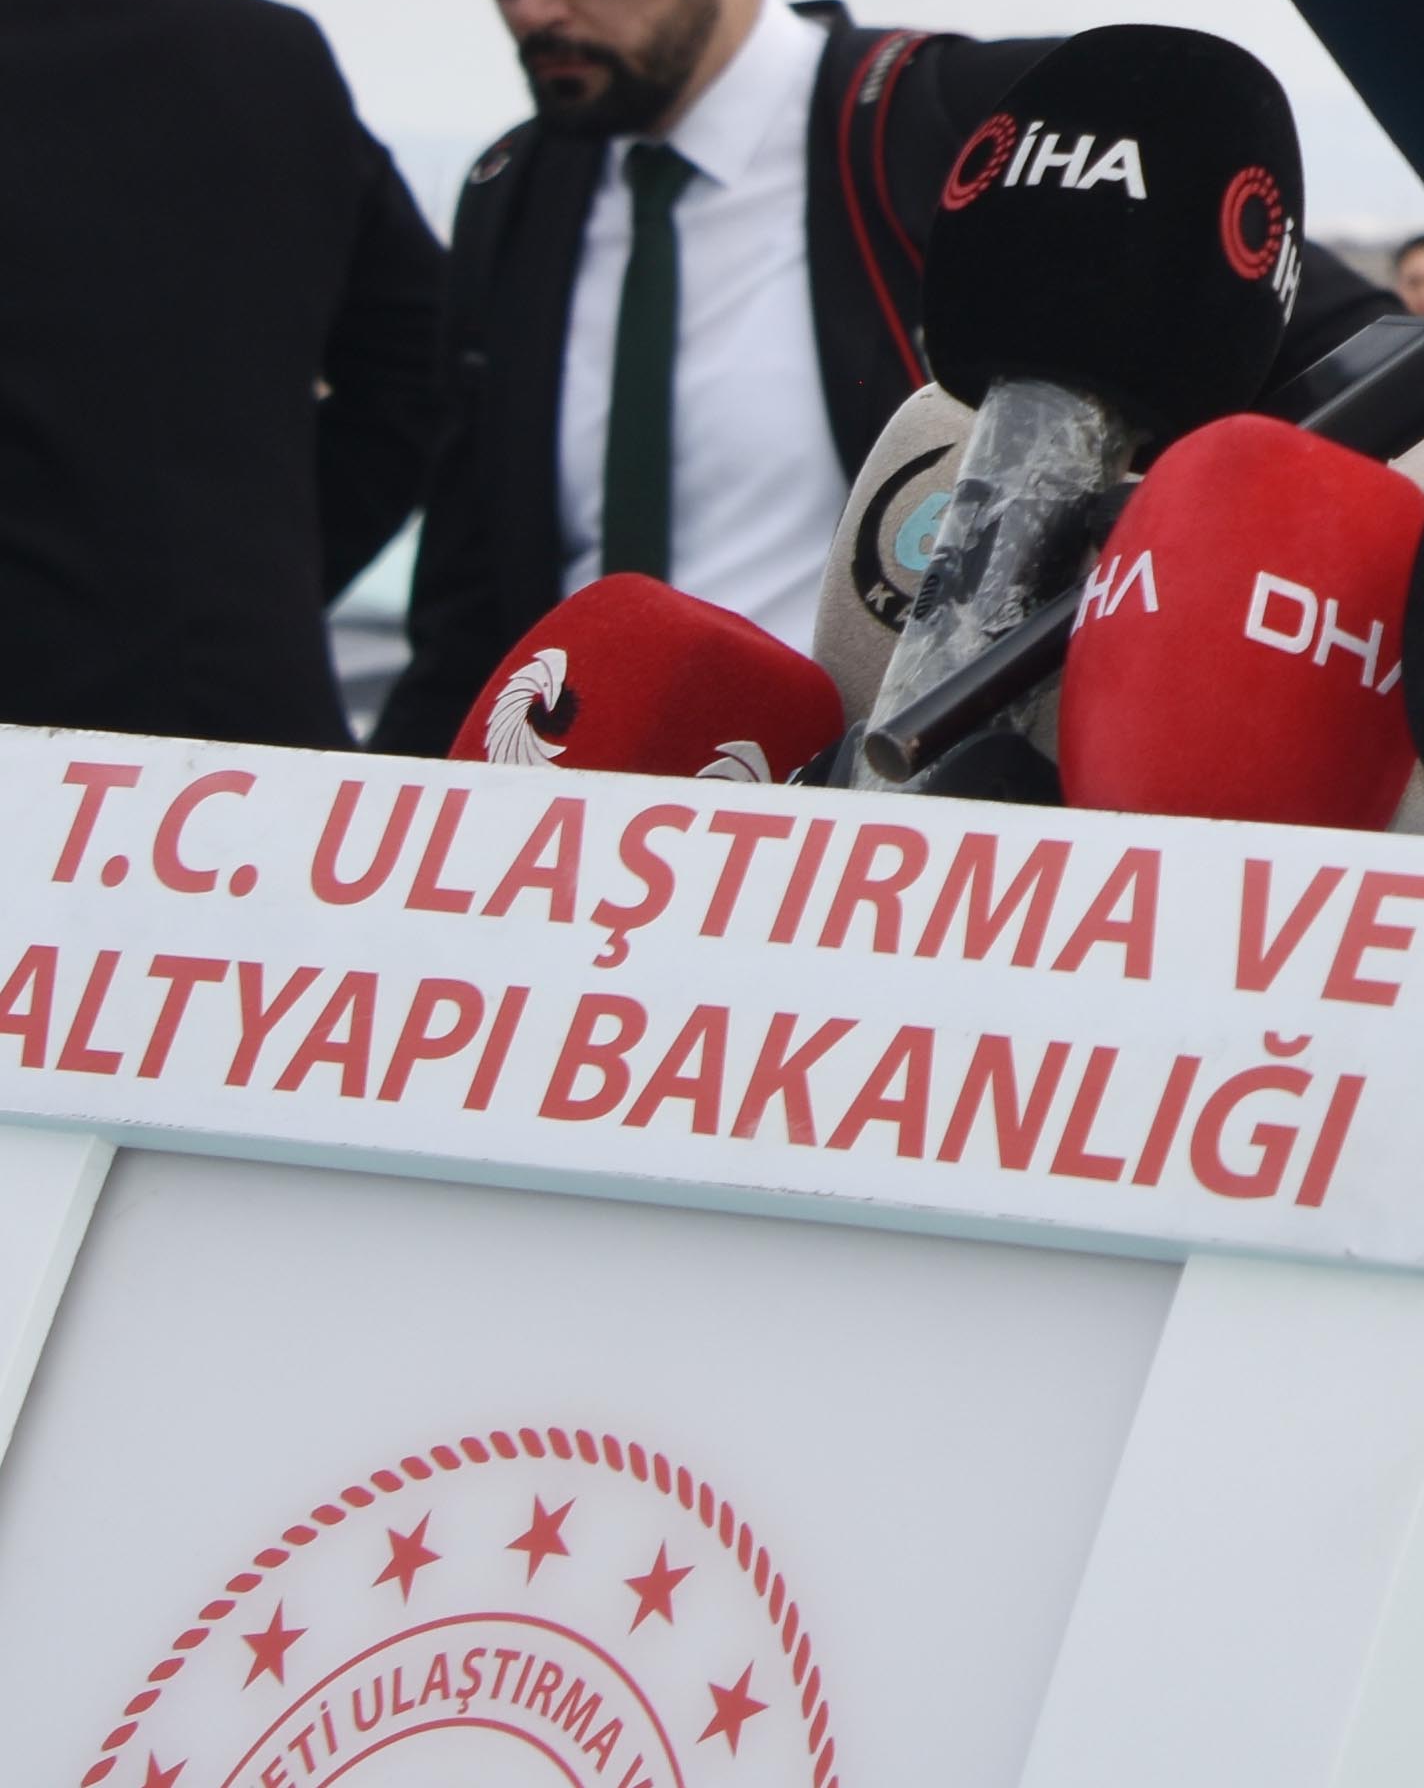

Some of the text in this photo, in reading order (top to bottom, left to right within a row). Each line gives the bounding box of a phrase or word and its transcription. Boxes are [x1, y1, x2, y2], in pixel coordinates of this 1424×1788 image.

[1004, 121, 1147, 199] İHA
[52, 761, 259, 898] T.C.
[310, 780, 1161, 981] ULAŞTIRMA
[0, 945, 1366, 1208] ALTYAPI BAKANLIĞI
[351, 1648, 624, 1773] ULAŞTIRMA
